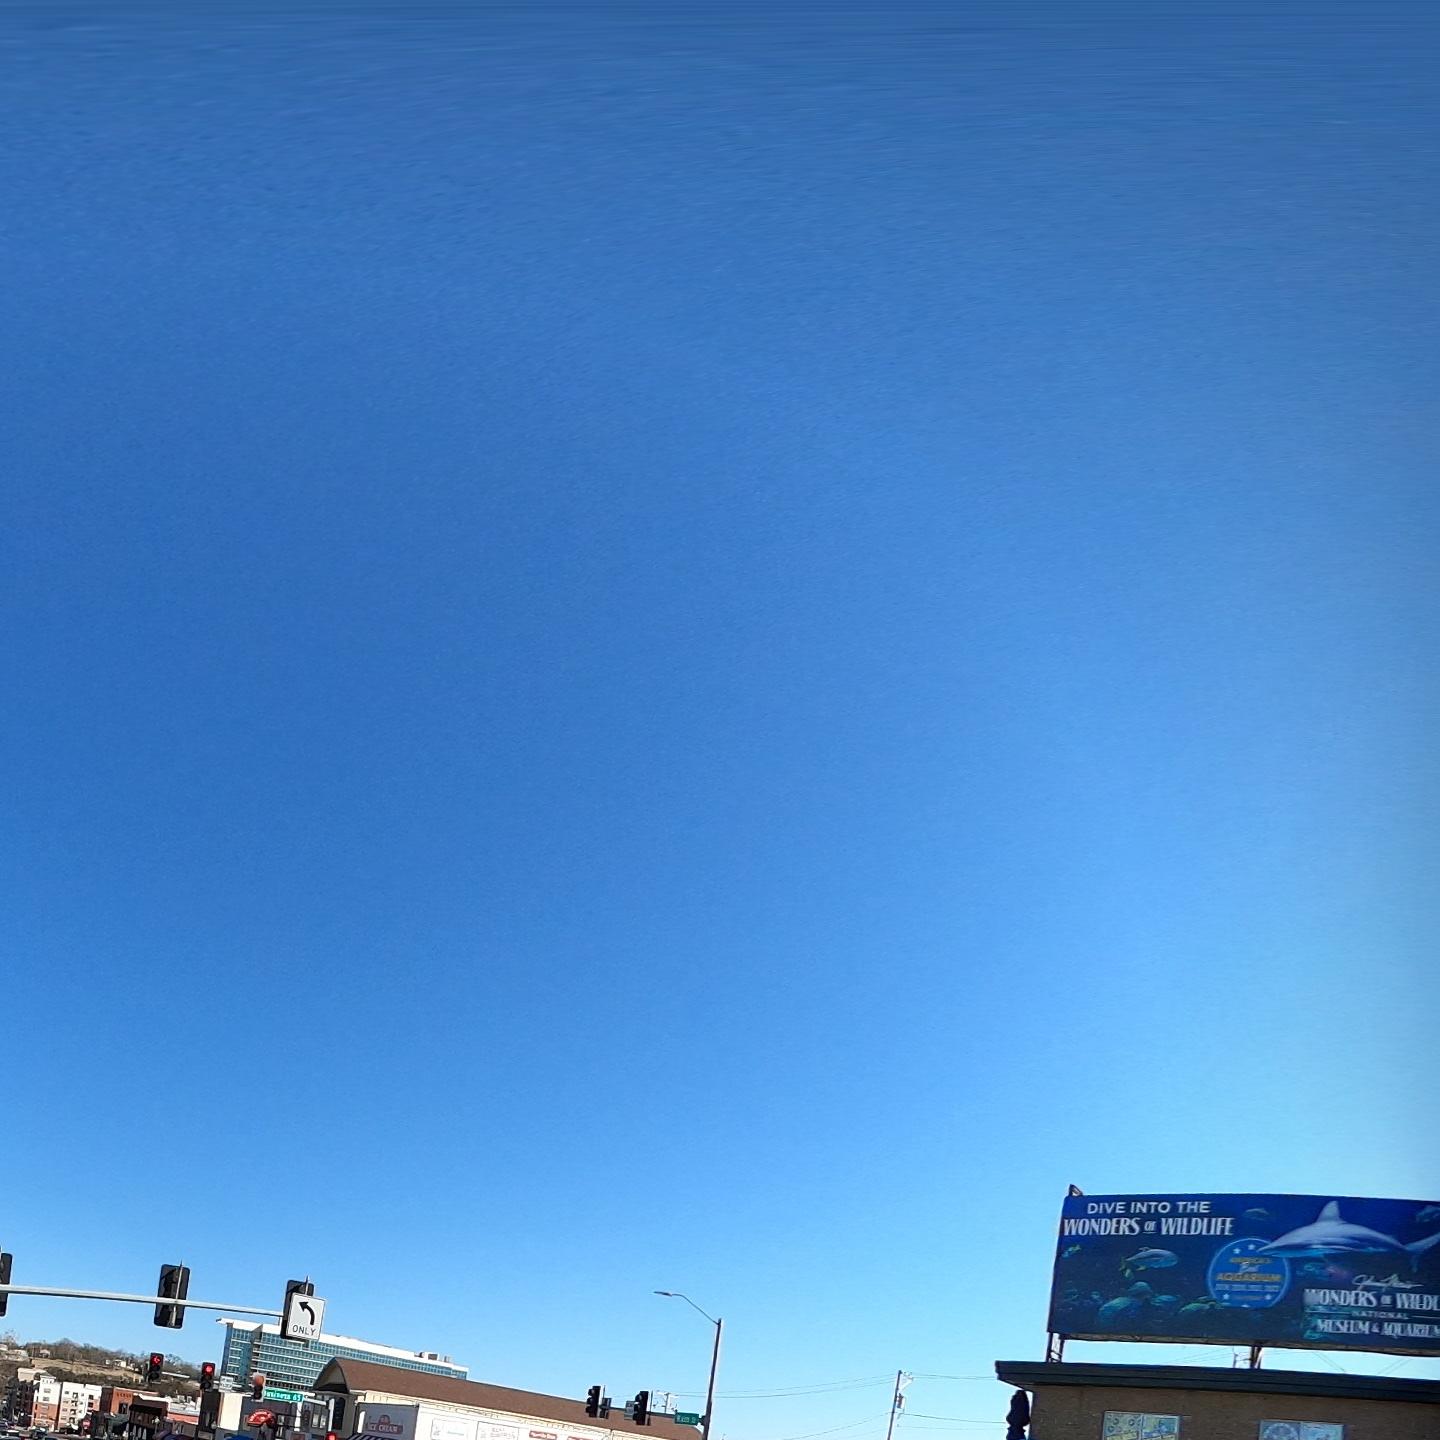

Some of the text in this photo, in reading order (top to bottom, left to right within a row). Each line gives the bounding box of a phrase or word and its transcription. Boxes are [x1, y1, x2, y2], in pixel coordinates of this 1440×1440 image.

[1087, 1201, 1211, 1215] DIVE INTO THE
[1063, 1217, 1141, 1236] WONDERS
[1160, 1217, 1236, 1236] WILDLIFE
[1352, 1311, 1409, 1320] NATIONAL
[292, 1324, 316, 1337] ONLY
[1317, 1319, 1369, 1335] MUSEUM
[1371, 1323, 1380, 1333] &
